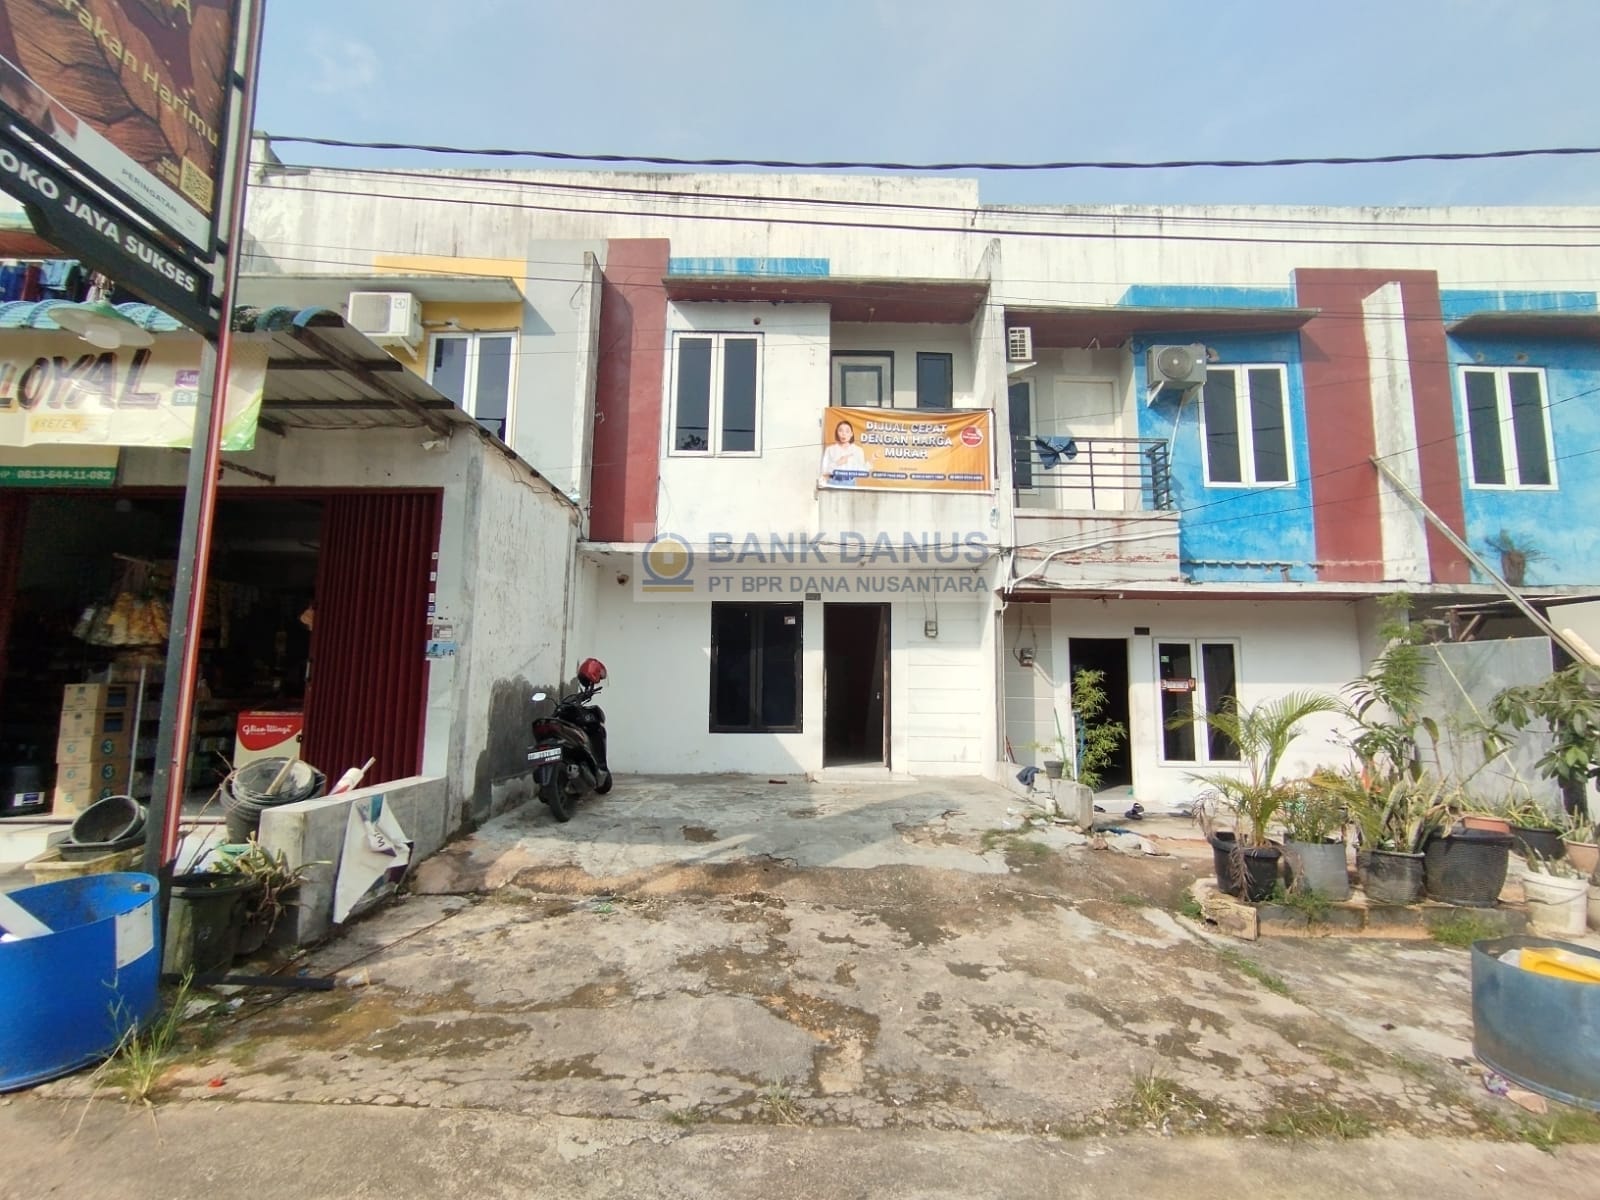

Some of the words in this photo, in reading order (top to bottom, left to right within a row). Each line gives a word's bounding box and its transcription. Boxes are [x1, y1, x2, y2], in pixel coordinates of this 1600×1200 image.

[57, 0, 137, 72] rakan
[143, 62, 217, 147] Harimu
[121, 168, 178, 214] PERINGATAN
[64, 196, 120, 244] JAYA
[124, 236, 195, 293] SUKSES
[860, 433, 908, 446] DENGAN
[912, 436, 953, 447] HARGA
[866, 421, 907, 433] DIJUAL
[911, 424, 947, 433] CEPAT
[885, 447, 928, 459] MURAH
